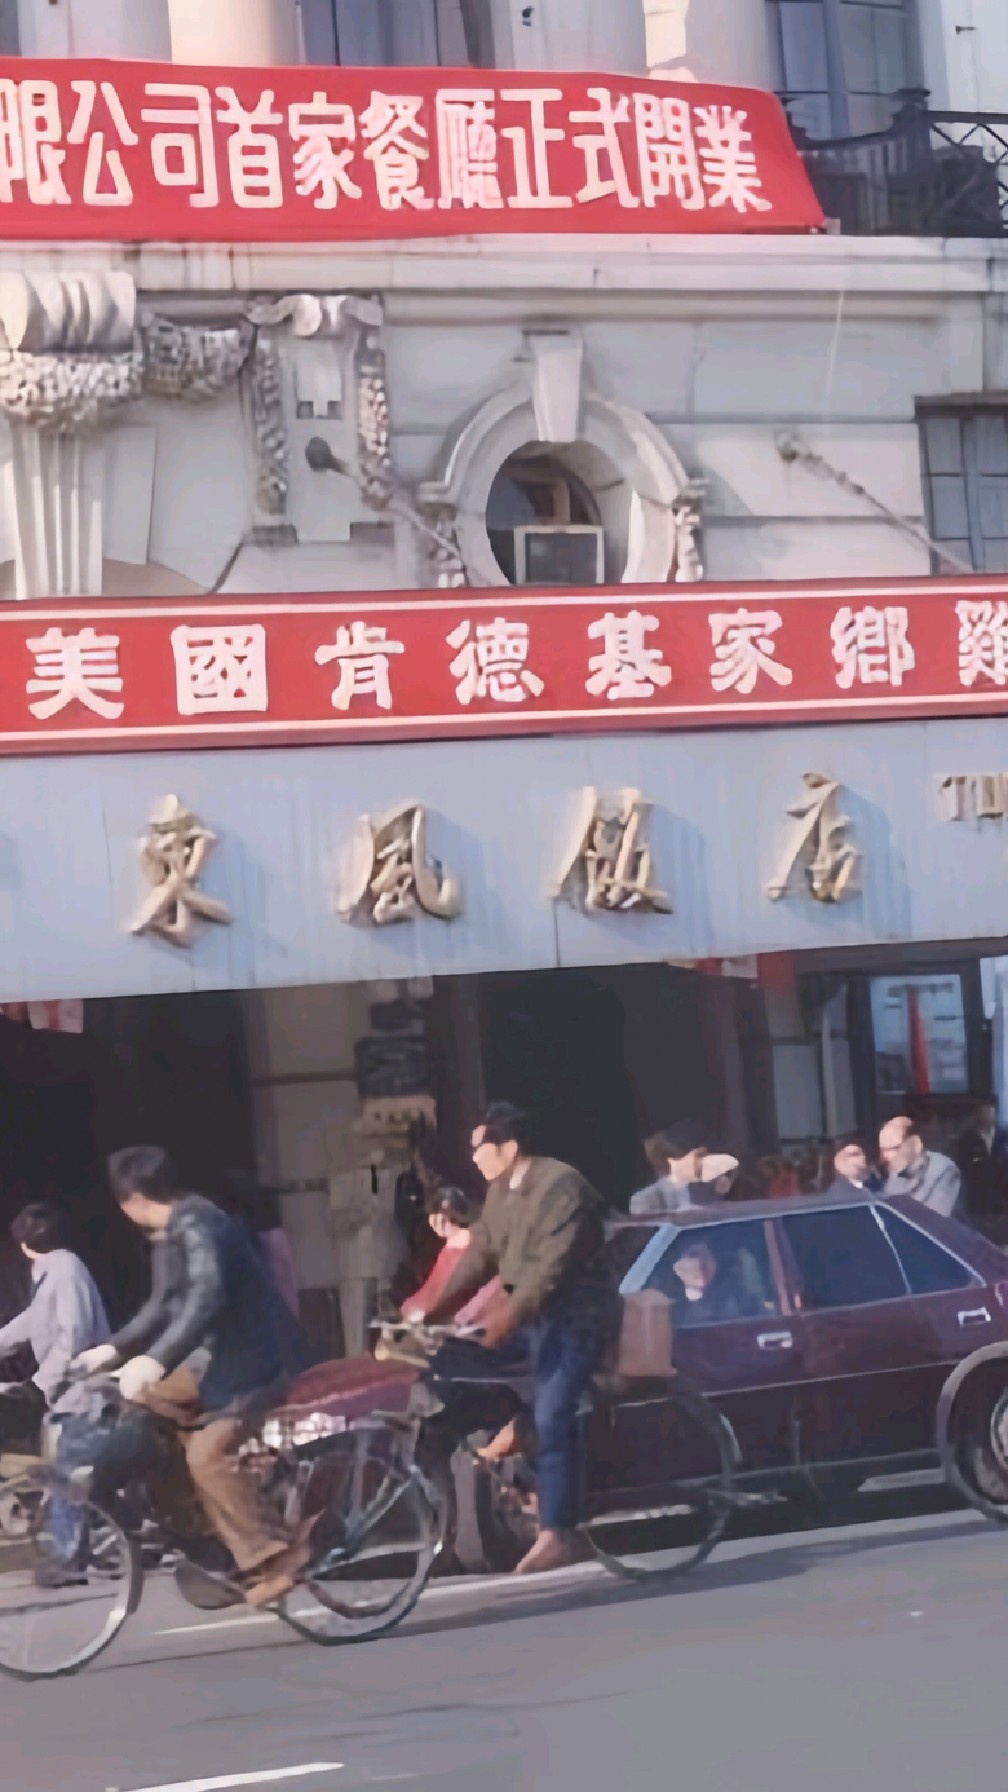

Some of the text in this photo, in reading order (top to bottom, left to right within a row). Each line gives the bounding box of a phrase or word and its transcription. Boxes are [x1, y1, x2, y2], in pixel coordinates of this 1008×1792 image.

[0, 78, 772, 213] 限公司首家餐廳正式開業
